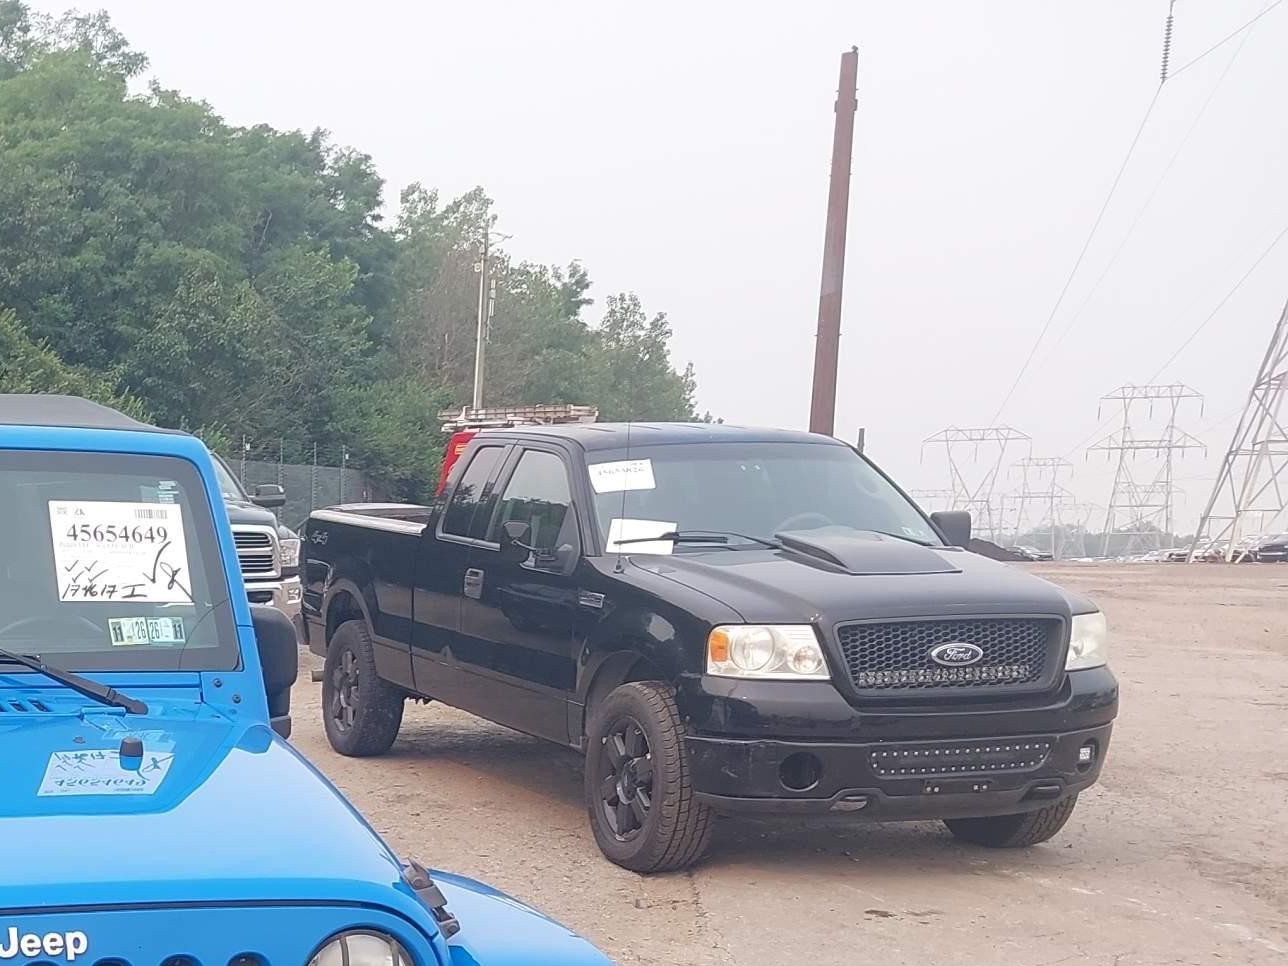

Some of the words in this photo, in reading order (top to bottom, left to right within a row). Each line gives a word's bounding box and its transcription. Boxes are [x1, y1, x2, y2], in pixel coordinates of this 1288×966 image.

[66, 524, 168, 543] 45654649
[112, 624, 125, 642] 11
[135, 621, 147, 640] 26
[149, 621, 160, 640] 26
[943, 647, 972, 661] Ford
